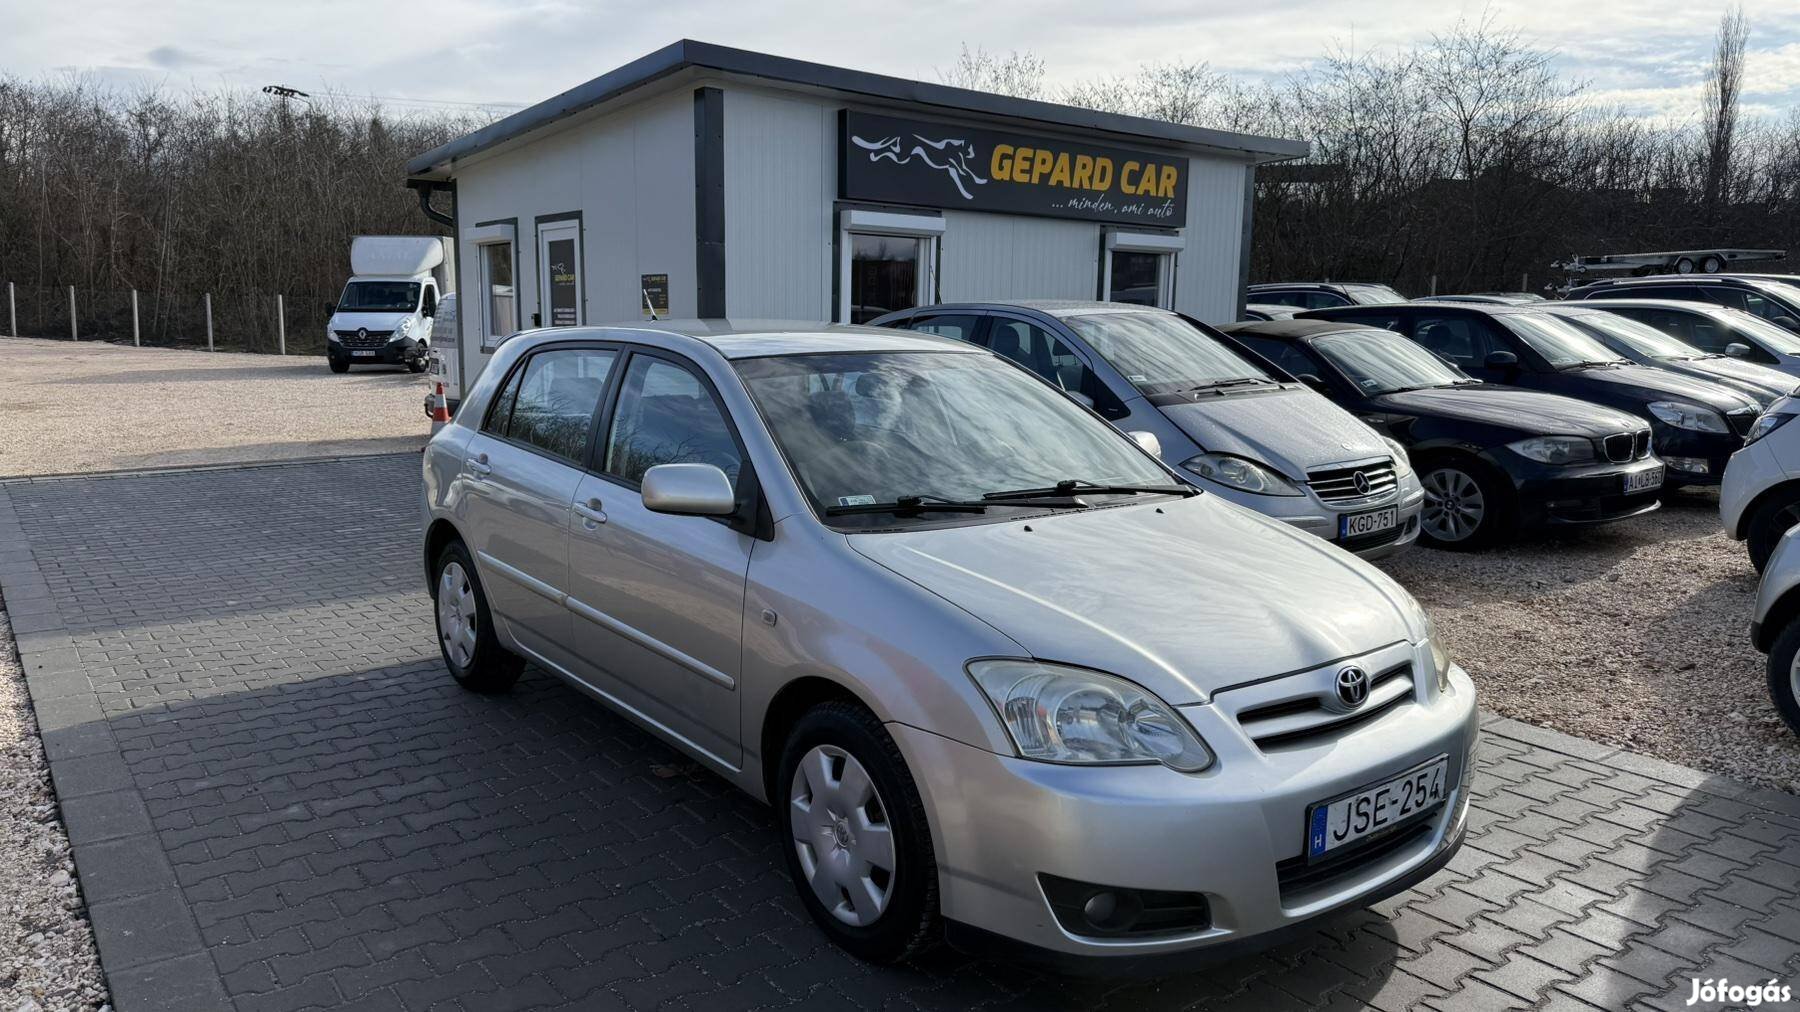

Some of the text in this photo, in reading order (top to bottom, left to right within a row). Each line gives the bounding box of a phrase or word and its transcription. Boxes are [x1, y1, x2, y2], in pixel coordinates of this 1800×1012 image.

[990, 144, 1178, 198] GEPARD CAR
[1068, 193, 1117, 214] minden,
[1121, 203, 1145, 215] ami
[1349, 510, 1394, 535] KGD-751
[1333, 768, 1440, 841] JSE-254
[1314, 834, 1323, 848] H
